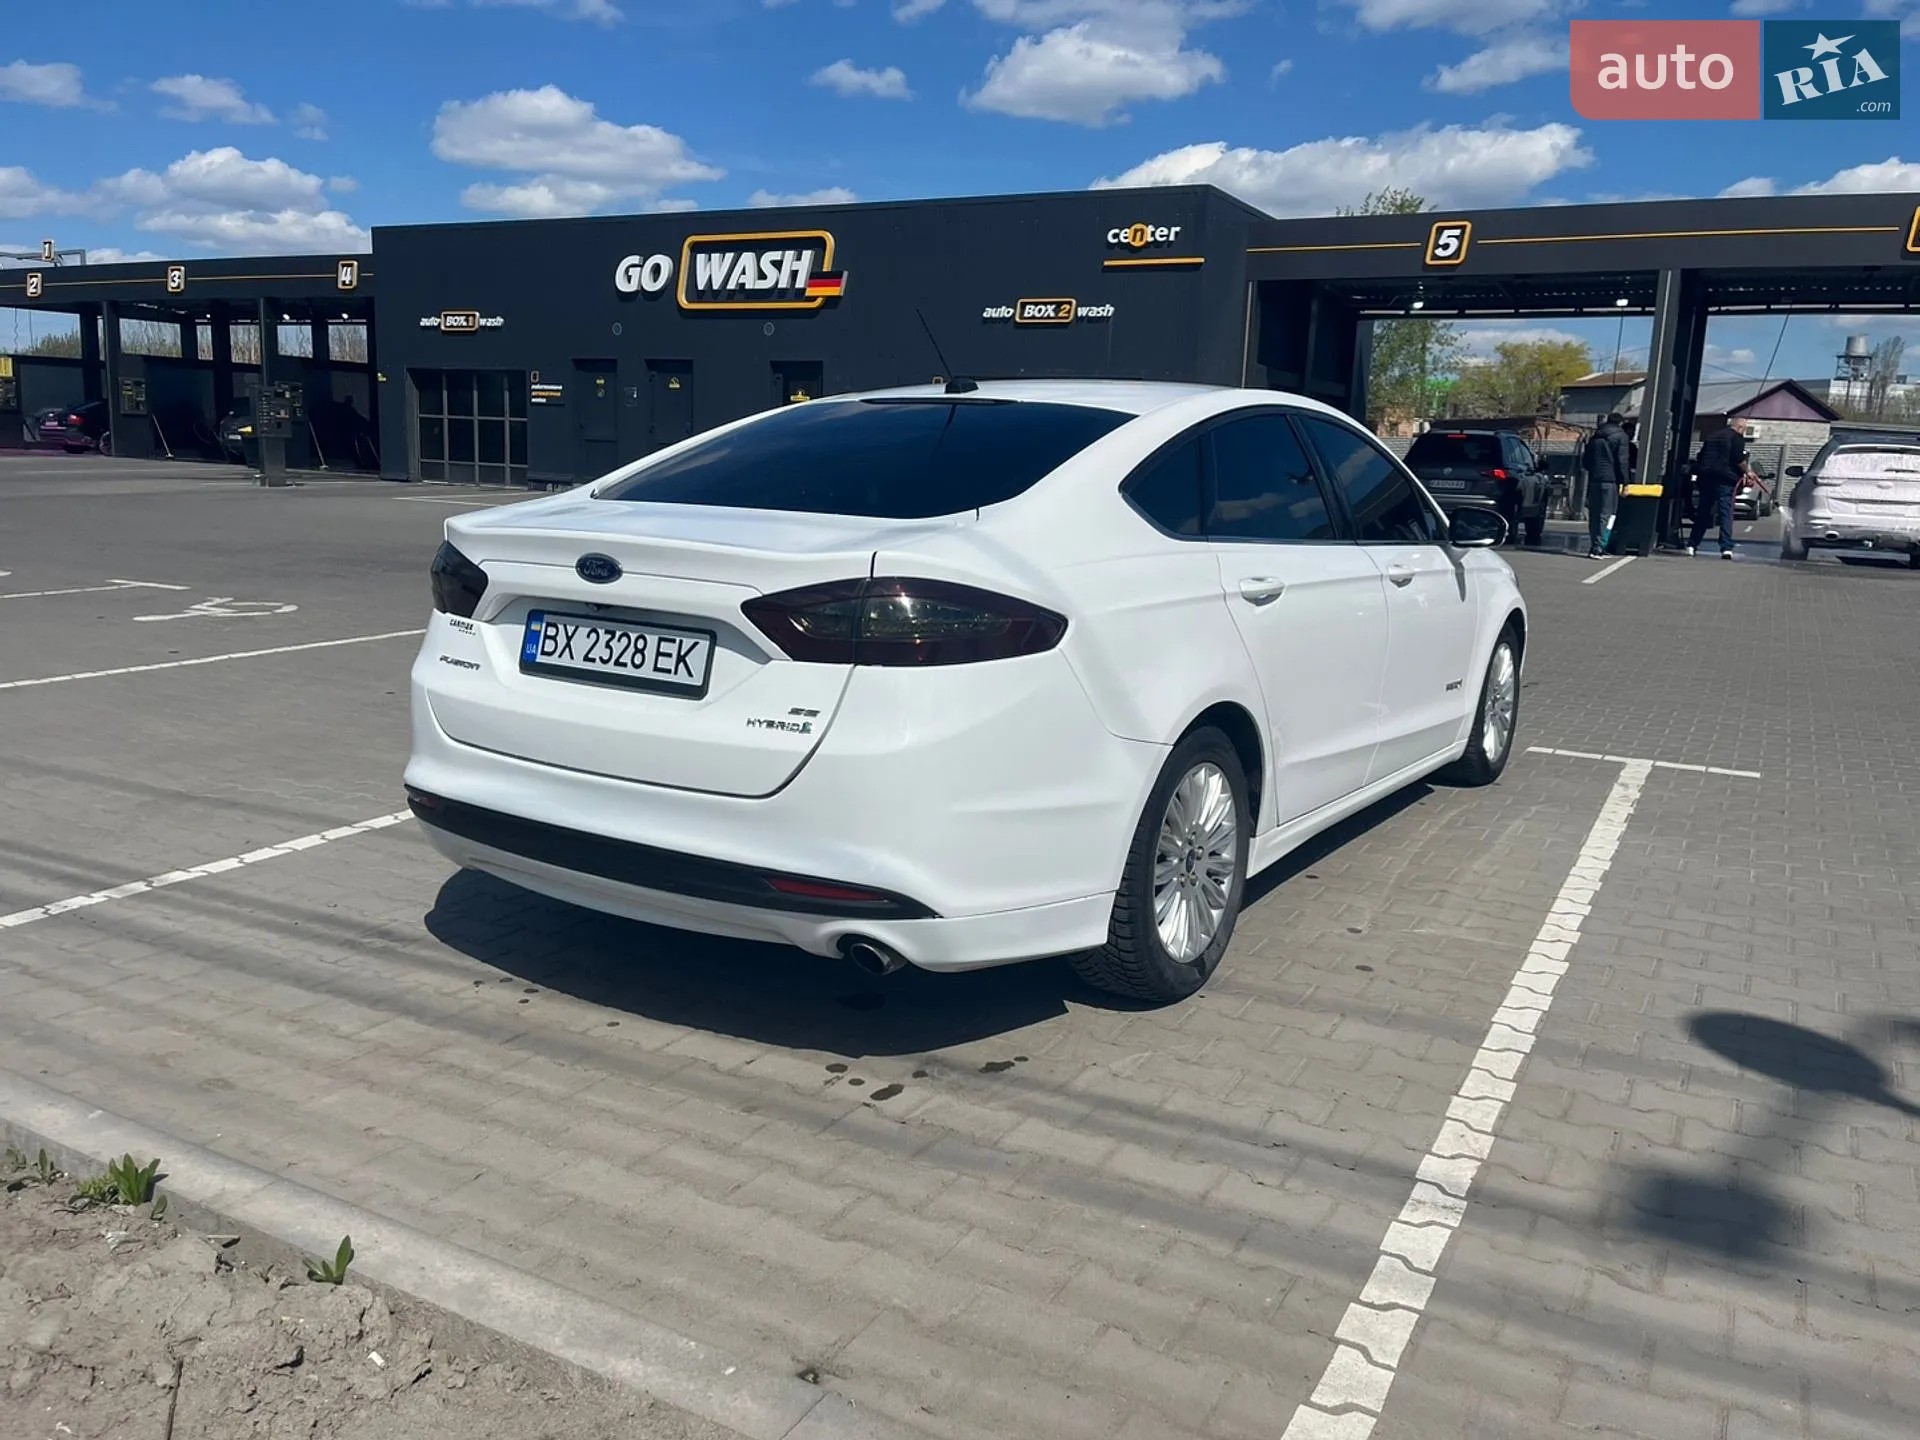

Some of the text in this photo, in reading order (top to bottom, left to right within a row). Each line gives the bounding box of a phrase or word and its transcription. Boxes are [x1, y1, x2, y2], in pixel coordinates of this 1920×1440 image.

[1107, 223, 1181, 247] center
[1434, 229, 1461, 257] 5
[170, 270, 181, 288] 3
[341, 266, 352, 284] 4
[615, 250, 815, 293] GO WASH
[29, 277, 38, 293] 2
[983, 304, 1115, 318] auto BOX 2 wash
[420, 316, 440, 327] auto
[445, 315, 467, 327] BOX
[479, 316, 504, 327] wash
[583, 559, 609, 577] Ford
[540, 621, 700, 678] BX 2328 EK
